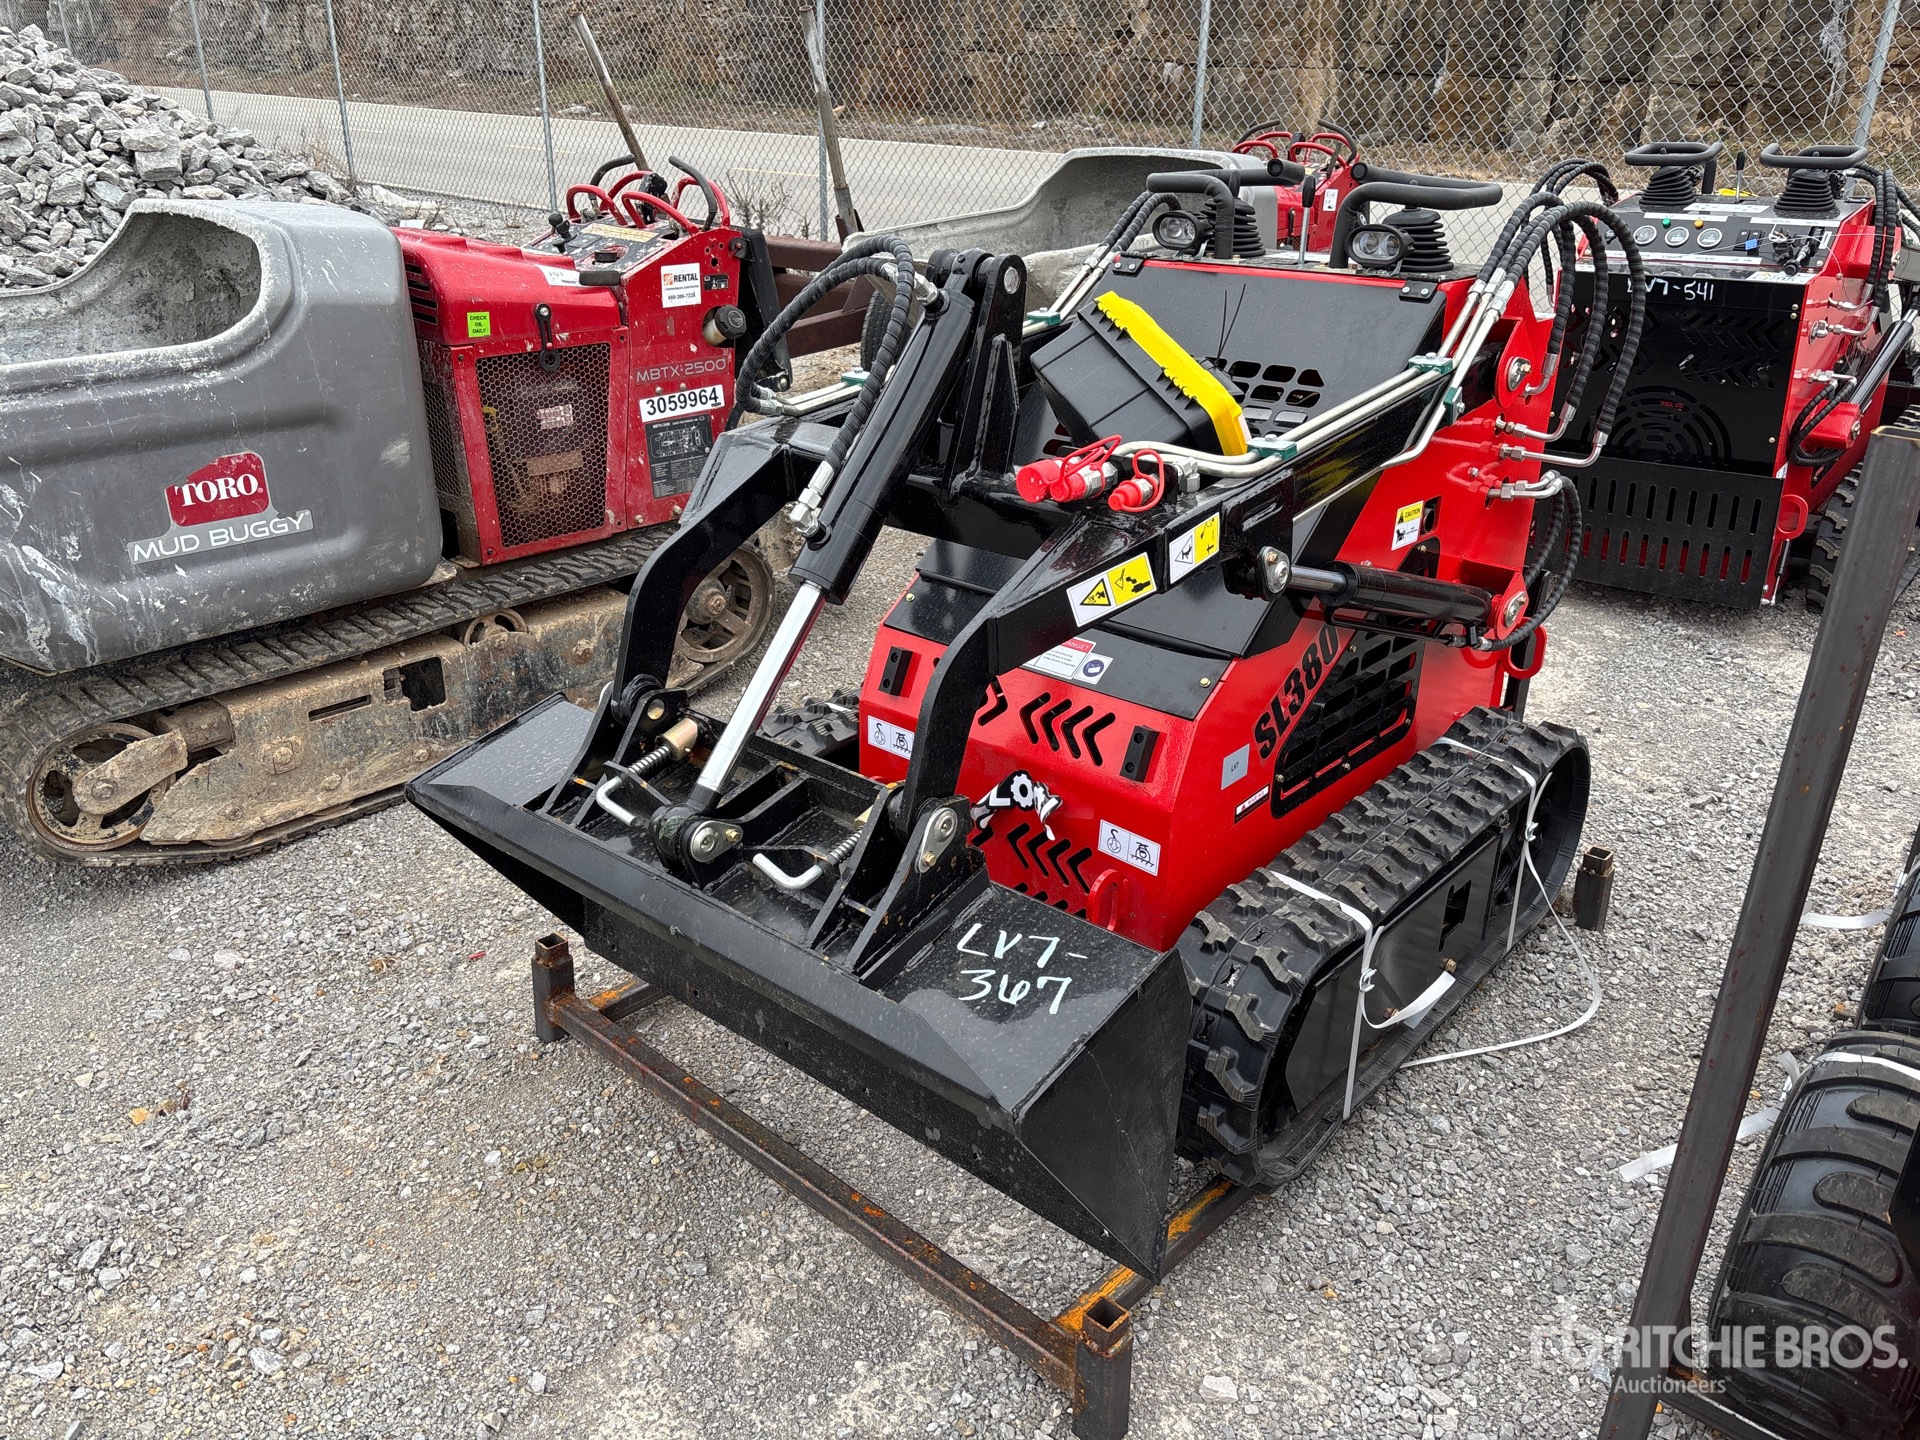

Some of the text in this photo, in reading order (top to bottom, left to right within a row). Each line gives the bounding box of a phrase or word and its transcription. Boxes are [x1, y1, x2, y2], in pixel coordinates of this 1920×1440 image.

[673, 273, 699, 283] RENTAL
[646, 387, 719, 416] 3059964
[174, 473, 259, 507] TORO
[1404, 508, 1421, 518] CAUTION
[133, 513, 305, 562] MUD BUGGY
[1254, 622, 1339, 760] SL380
[957, 922, 1088, 969] LV7-
[958, 969, 1073, 1015] 367
